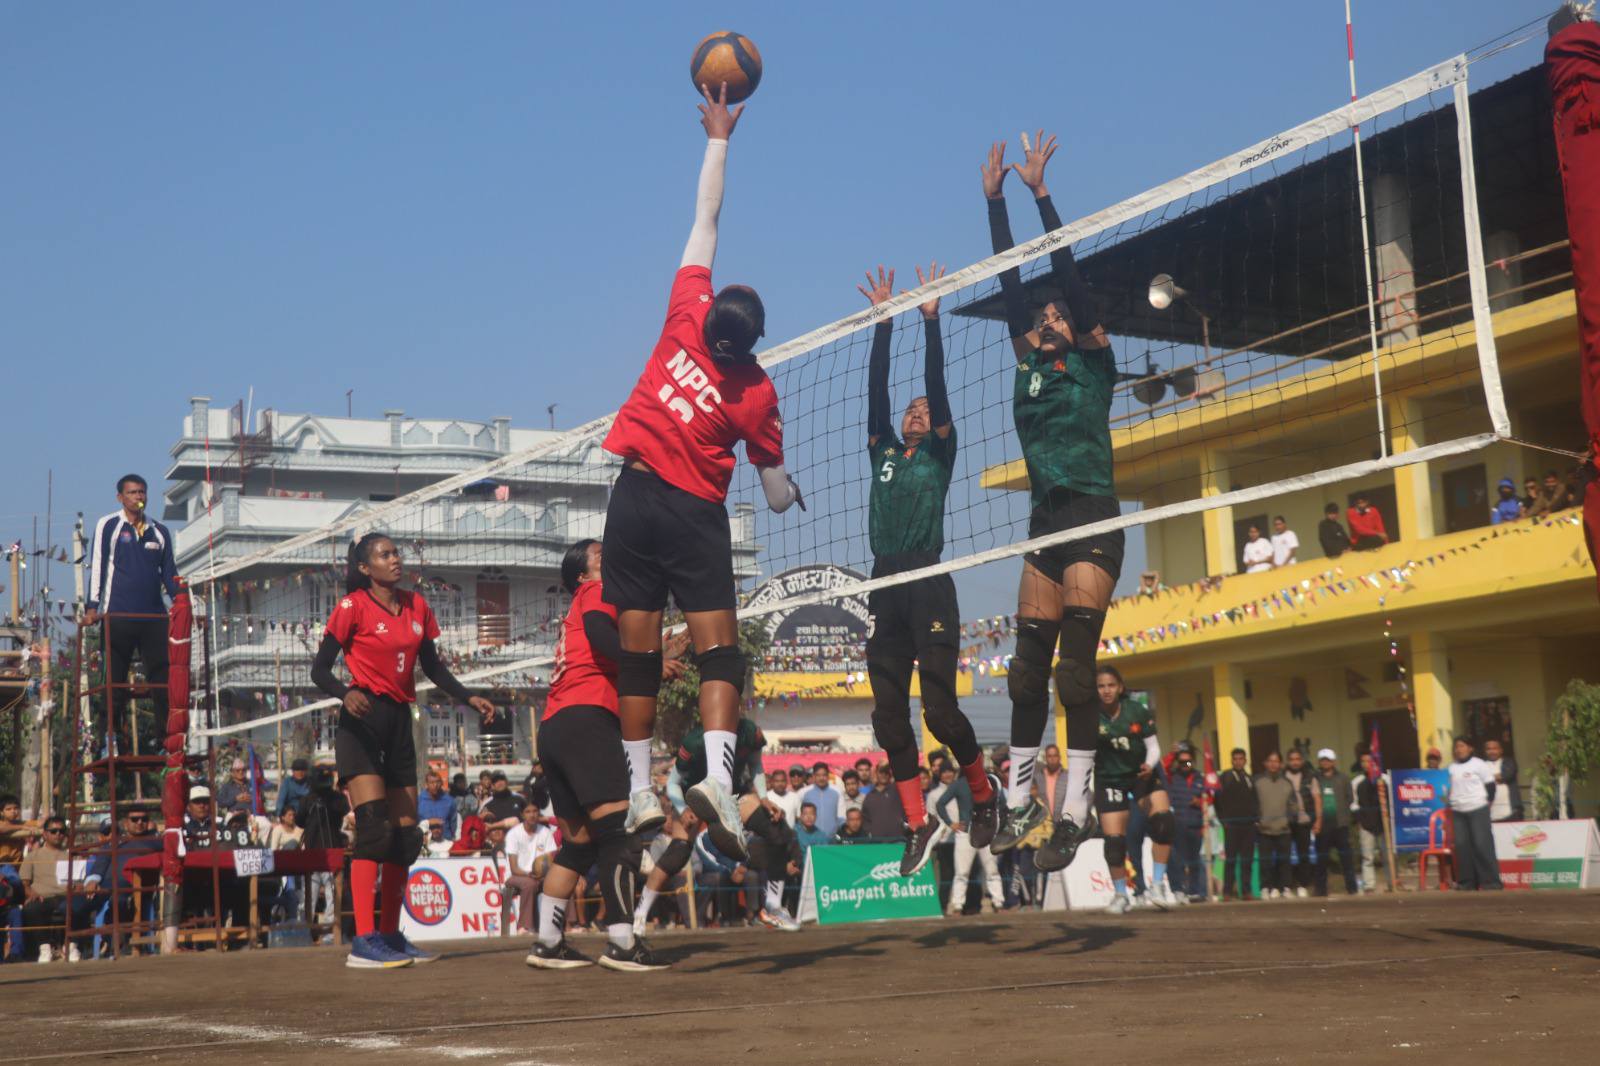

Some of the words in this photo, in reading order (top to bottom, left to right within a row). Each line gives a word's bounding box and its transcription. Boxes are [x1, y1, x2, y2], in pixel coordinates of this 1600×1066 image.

[665, 348, 722, 413] NPC
[1028, 371, 1043, 398] 8
[880, 461, 896, 482] 5
[866, 615, 876, 639] 5
[396, 652, 406, 673] 3
[242, 860, 268, 874] DESK
[409, 884, 434, 894] GAME
[435, 883, 446, 893] OF
[820, 882, 886, 909] Ganapati
[889, 878, 935, 899] Bakers
[410, 892, 449, 907] NEPAL
[435, 906, 448, 917] HD
